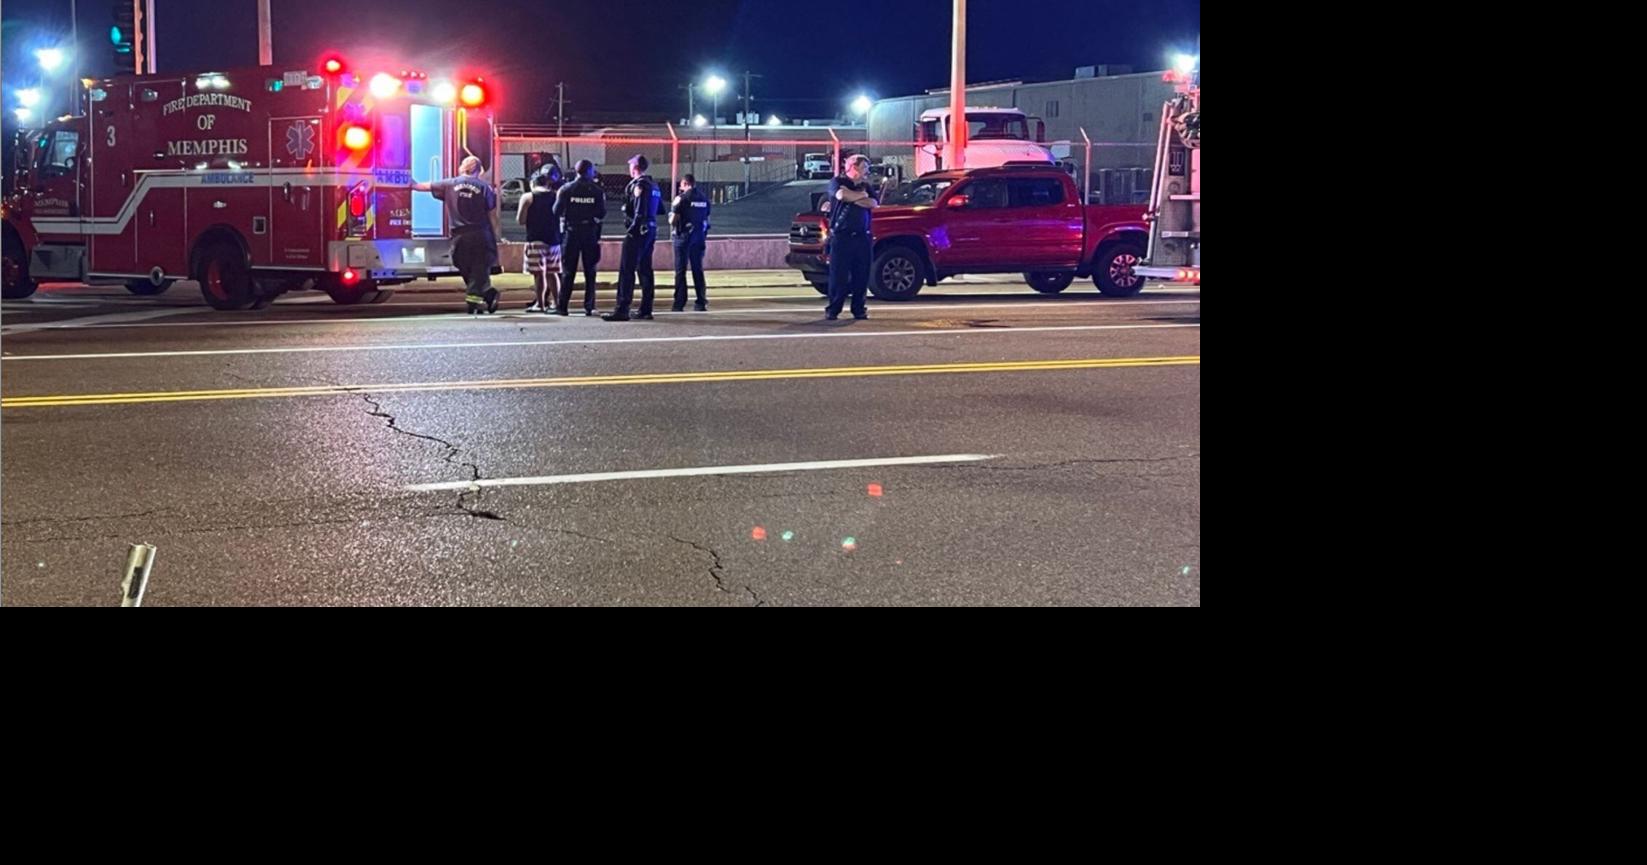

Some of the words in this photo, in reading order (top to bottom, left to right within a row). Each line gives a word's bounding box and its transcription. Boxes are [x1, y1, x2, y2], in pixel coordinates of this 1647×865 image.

[163, 97, 185, 116] FIRE
[186, 93, 252, 112] DEPARTMENT
[197, 114, 216, 130] OF
[106, 125, 116, 147] 3
[167, 139, 248, 156] MEMPHIS
[201, 172, 255, 184] AMBULANCE
